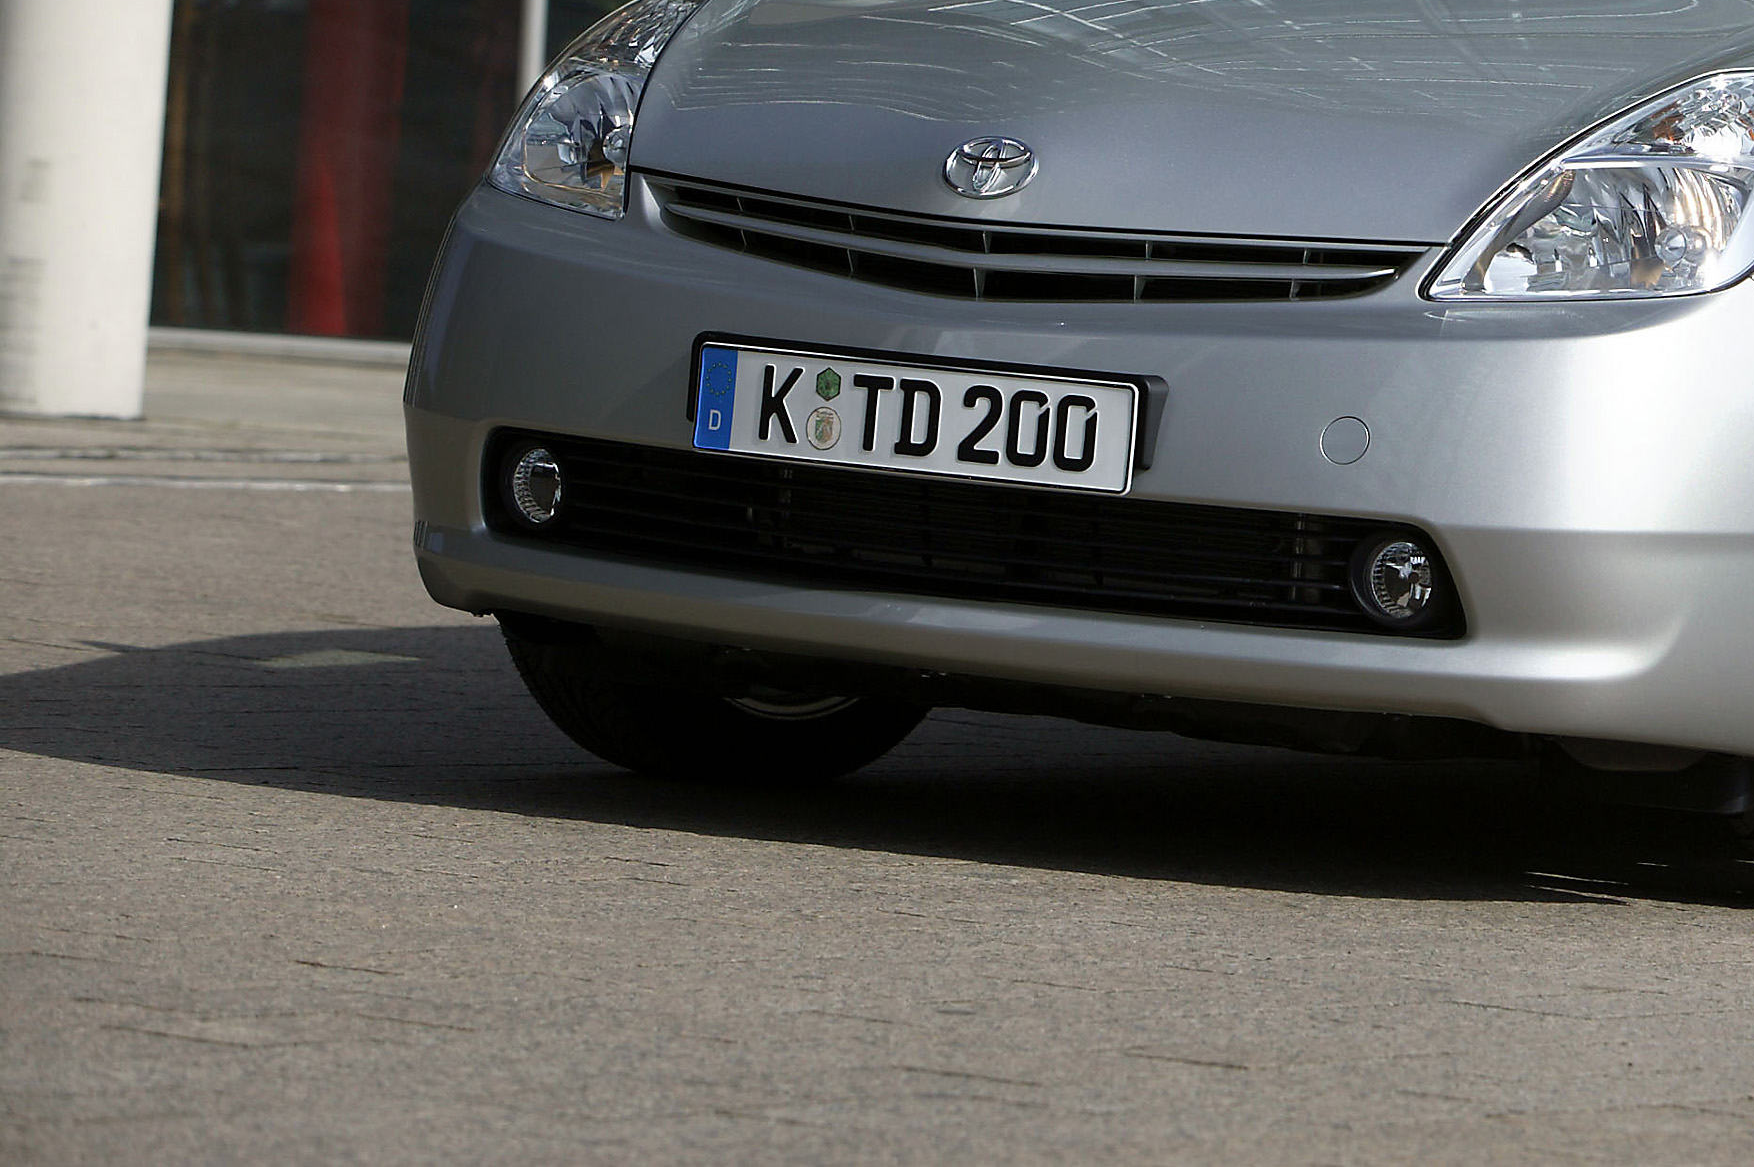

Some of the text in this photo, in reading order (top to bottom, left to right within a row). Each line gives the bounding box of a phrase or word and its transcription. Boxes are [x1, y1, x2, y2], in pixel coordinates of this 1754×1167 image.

[708, 409, 721, 431] D
[758, 364, 1098, 473] K TD 200
